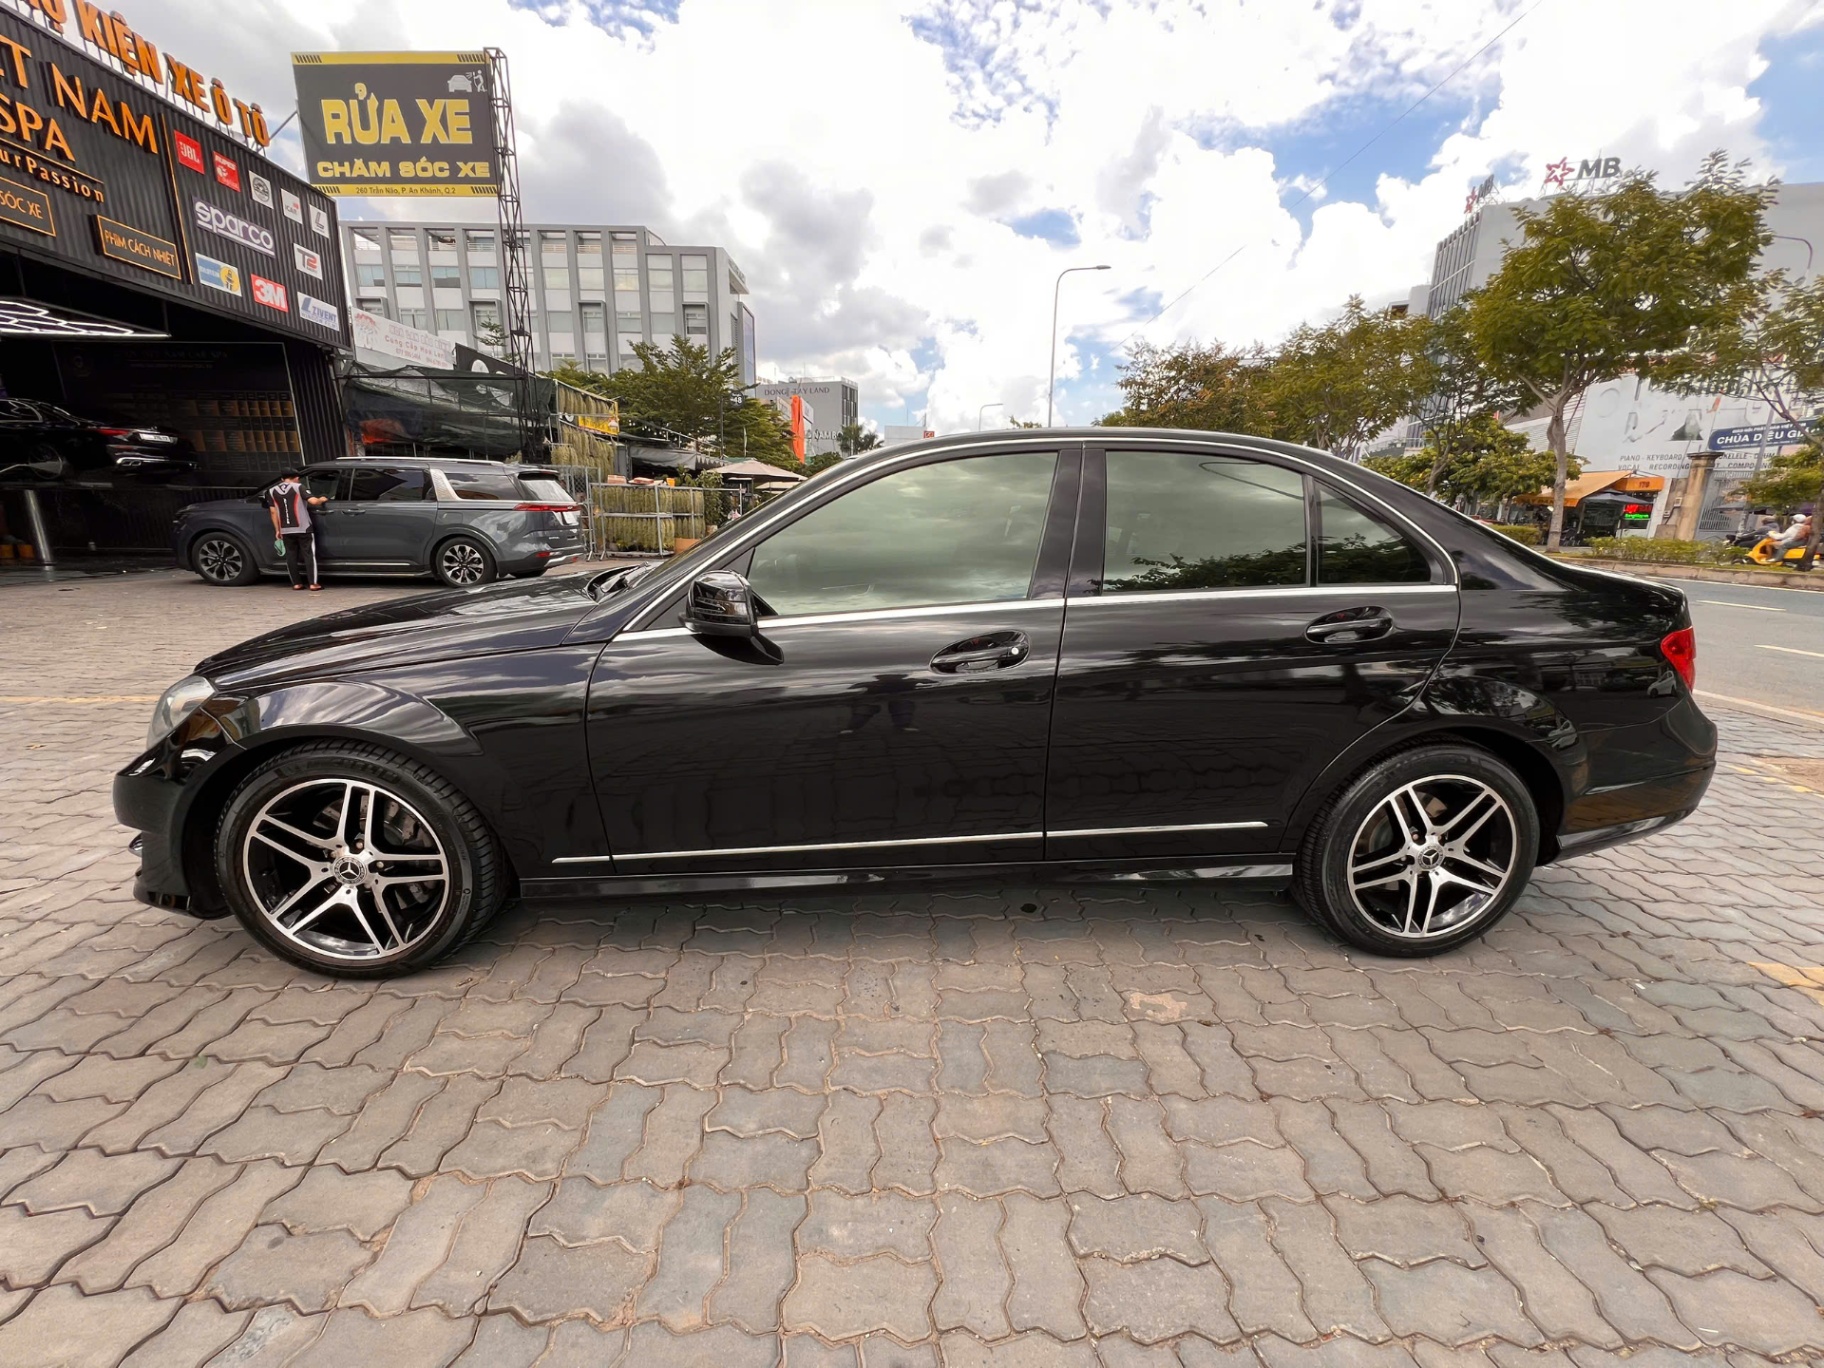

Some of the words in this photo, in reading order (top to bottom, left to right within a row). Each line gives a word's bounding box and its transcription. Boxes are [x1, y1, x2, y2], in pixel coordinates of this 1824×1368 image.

[76, 0, 163, 84] KIỆN
[165, 53, 210, 113] XE
[211, 78, 233, 126] Ô
[233, 103, 270, 147] TÔ
[51, 62, 158, 154] NAM
[320, 82, 411, 144] RỬA
[415, 99, 473, 144] XE
[0, 93, 75, 161] SPA
[179, 141, 200, 163] JBL
[317, 158, 391, 177] CHĂM
[456, 161, 490, 177] XE
[1576, 157, 1621, 180] MB
[27, 200, 43, 219] XE
[195, 201, 273, 250] sparco
[104, 229, 126, 250] PHIM
[127, 238, 150, 258] CÁCH
[152, 247, 175, 267] NHIỆT
[255, 278, 287, 308] 3M
[1716, 433, 1749, 445] CHÙA
[1753, 430, 1784, 442] DỆU
[1646, 453, 1683, 461] KEYBOARD
